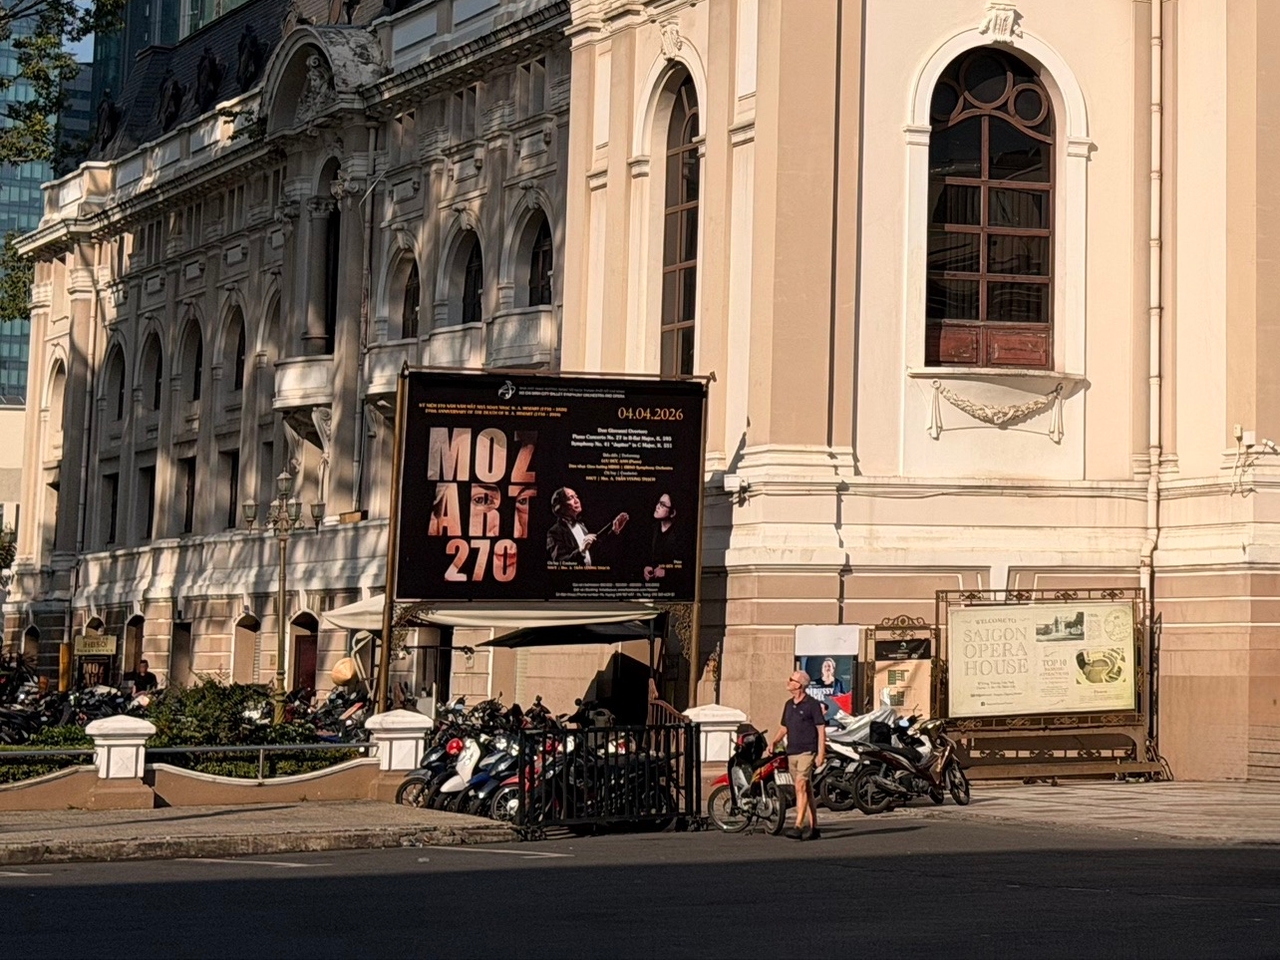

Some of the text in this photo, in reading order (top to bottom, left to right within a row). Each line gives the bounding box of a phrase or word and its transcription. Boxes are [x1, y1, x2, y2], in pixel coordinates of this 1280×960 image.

[618, 406, 684, 421] 04.04.2026
[427, 427, 539, 483] MOZ
[427, 482, 538, 538] ART
[444, 538, 518, 582] 270
[963, 627, 1028, 643] SAIGON
[963, 642, 1028, 659] OPERA
[963, 658, 1029, 676] HOUSE
[1042, 659, 1059, 667] TOP
